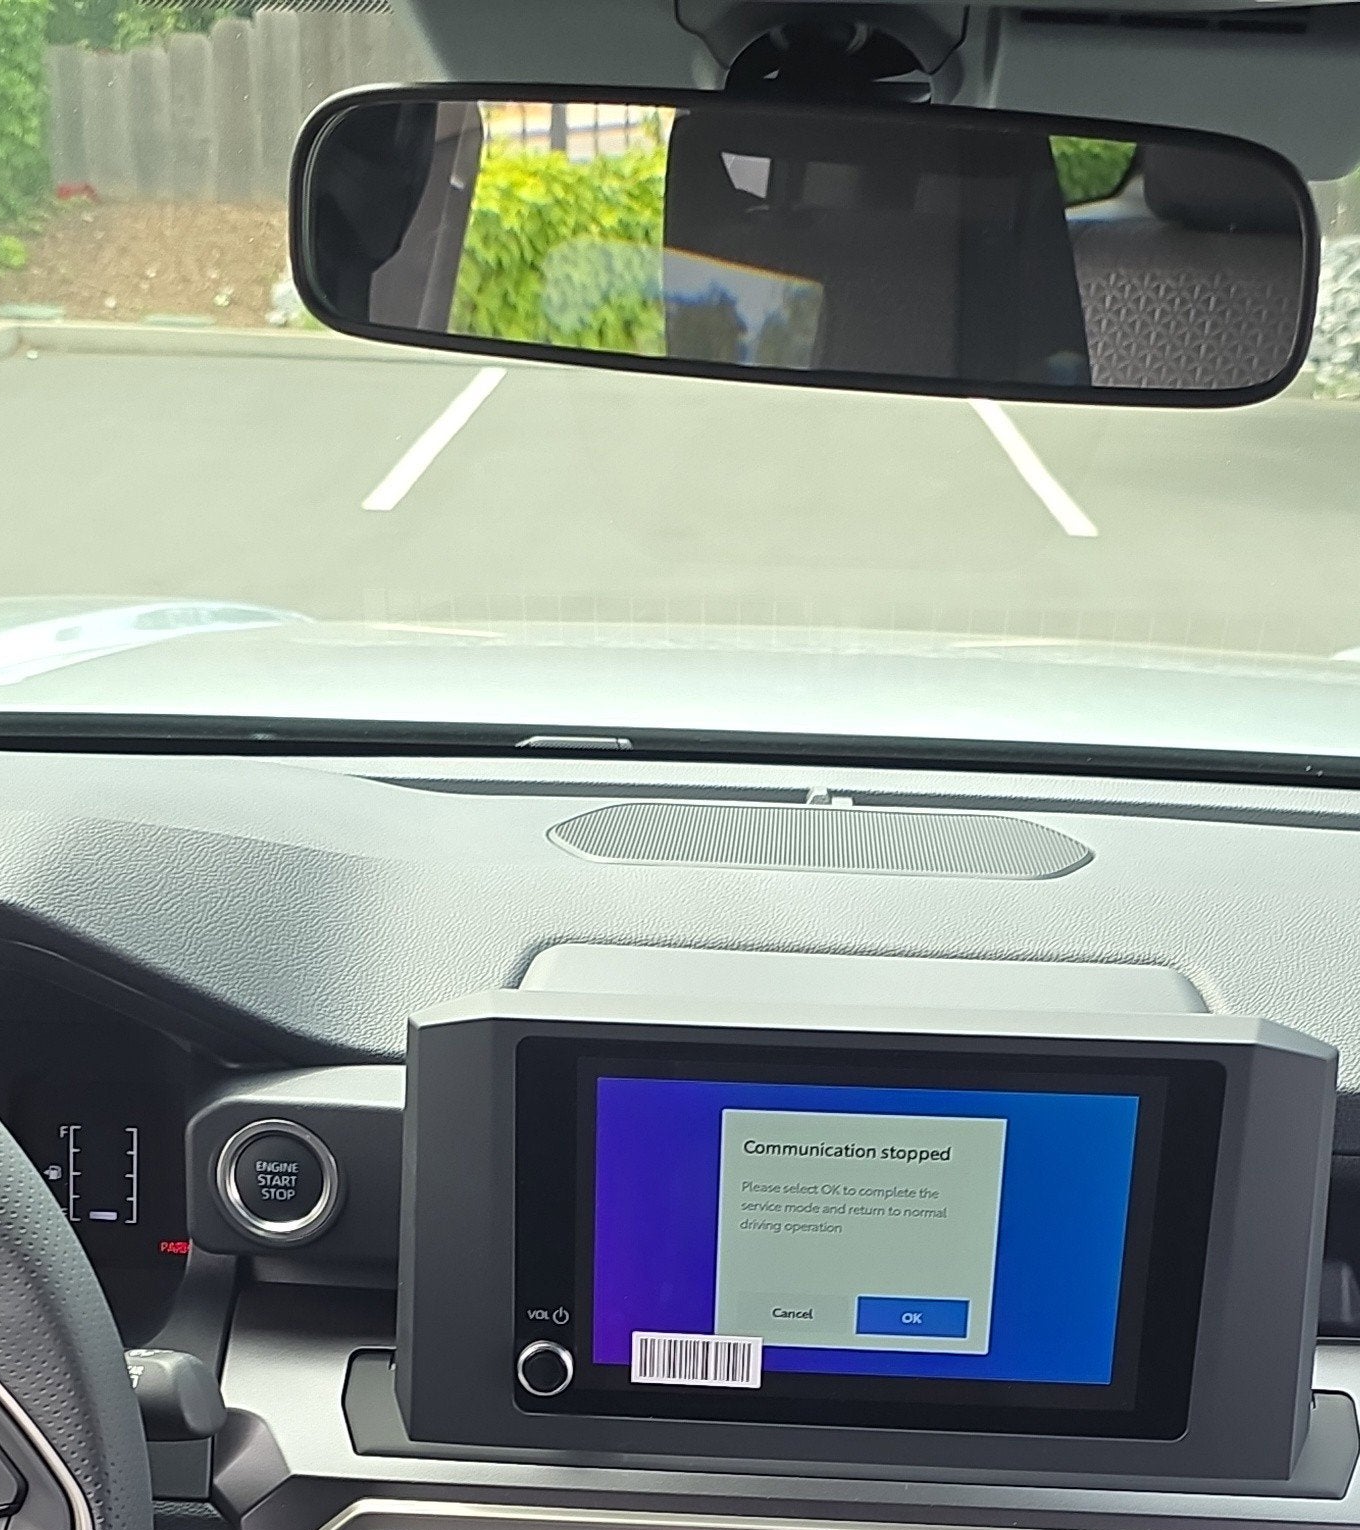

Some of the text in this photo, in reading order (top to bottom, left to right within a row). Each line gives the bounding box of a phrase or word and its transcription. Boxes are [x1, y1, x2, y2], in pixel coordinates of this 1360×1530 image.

[59, 1126, 69, 1138] F
[743, 1139, 952, 1164] Communication stopped
[256, 1160, 299, 1173] ENGINE
[257, 1174, 297, 1188] START
[261, 1187, 296, 1201] STOP
[741, 1181, 939, 1200] Please select OK to complete the
[741, 1201, 947, 1219] service mode and return to normal
[740, 1218, 782, 1234] driving
[527, 1309, 550, 1320] VOL
[772, 1307, 814, 1320] Cancel
[901, 1312, 923, 1324] OK
